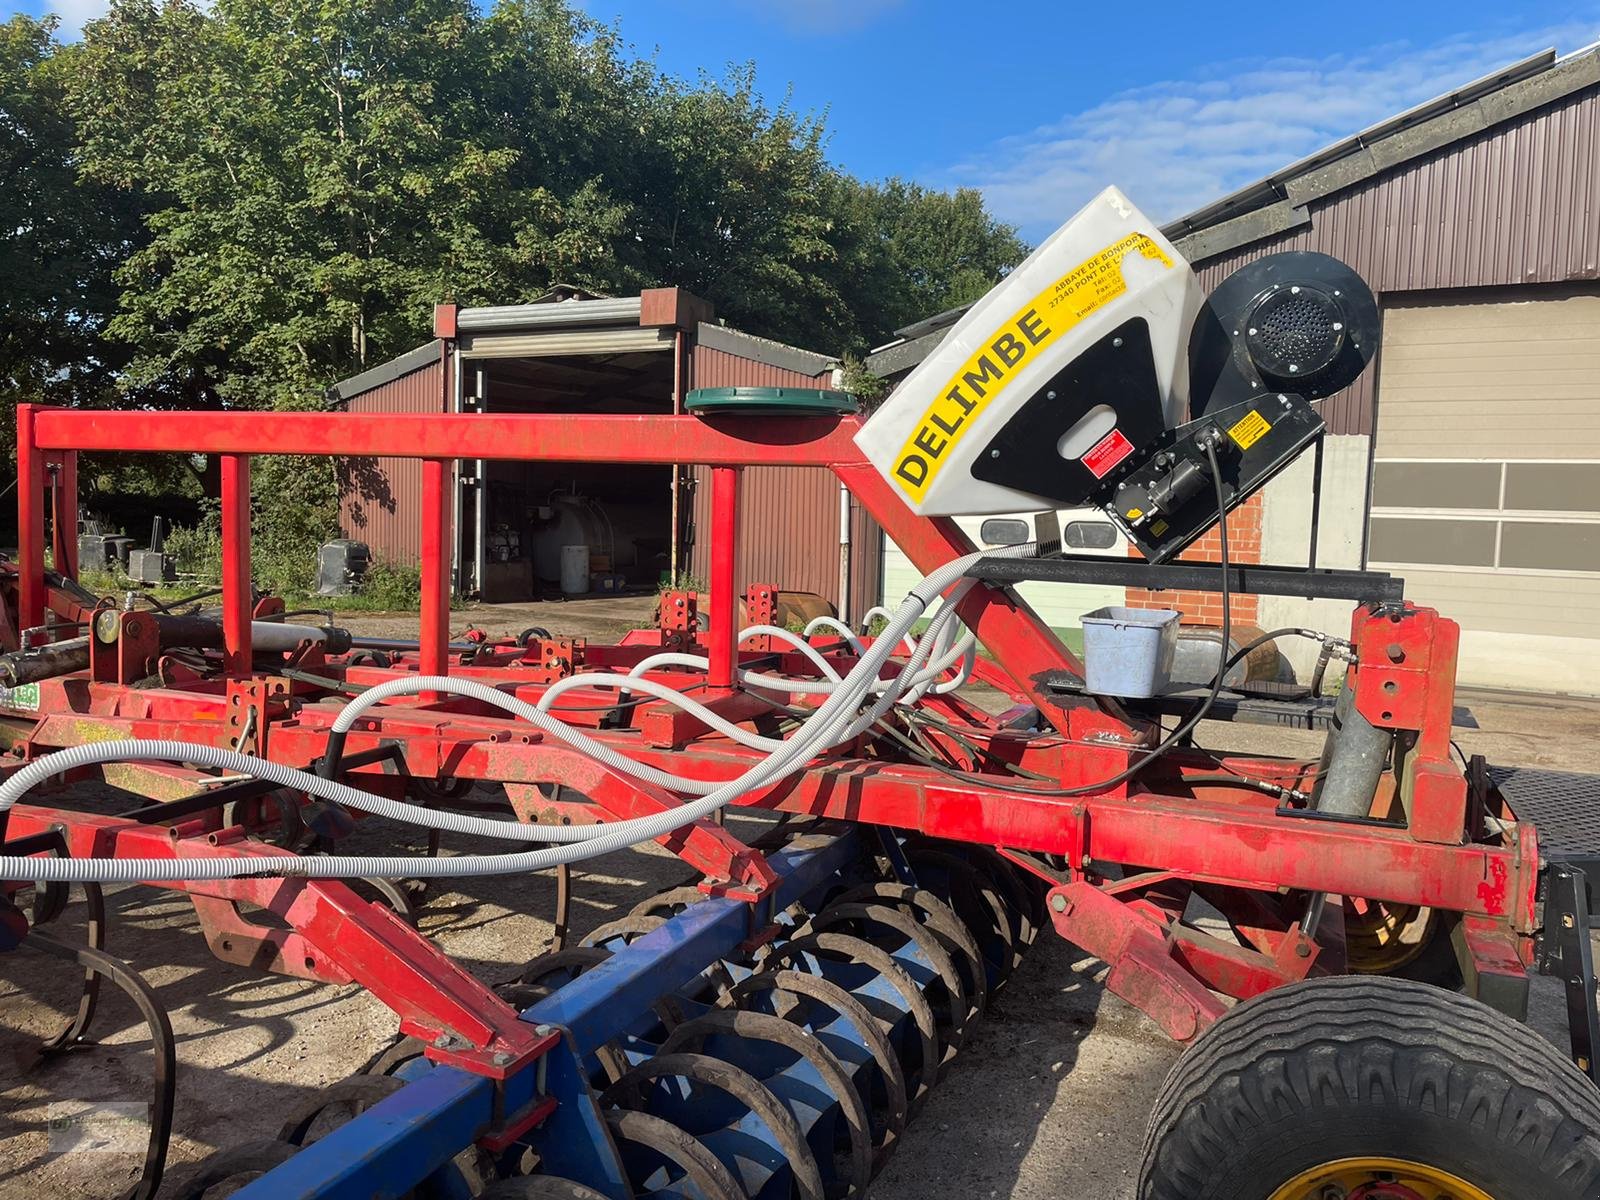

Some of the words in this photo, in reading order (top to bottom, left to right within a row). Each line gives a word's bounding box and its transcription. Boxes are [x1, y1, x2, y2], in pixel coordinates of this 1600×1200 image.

[1048, 287, 1075, 309] 27340
[1075, 271, 1099, 290] PONT
[1100, 262, 1113, 274] DE
[1055, 268, 1087, 293] ABBAYE
[1088, 258, 1101, 271] DE
[896, 308, 1053, 488] DELIMBE
